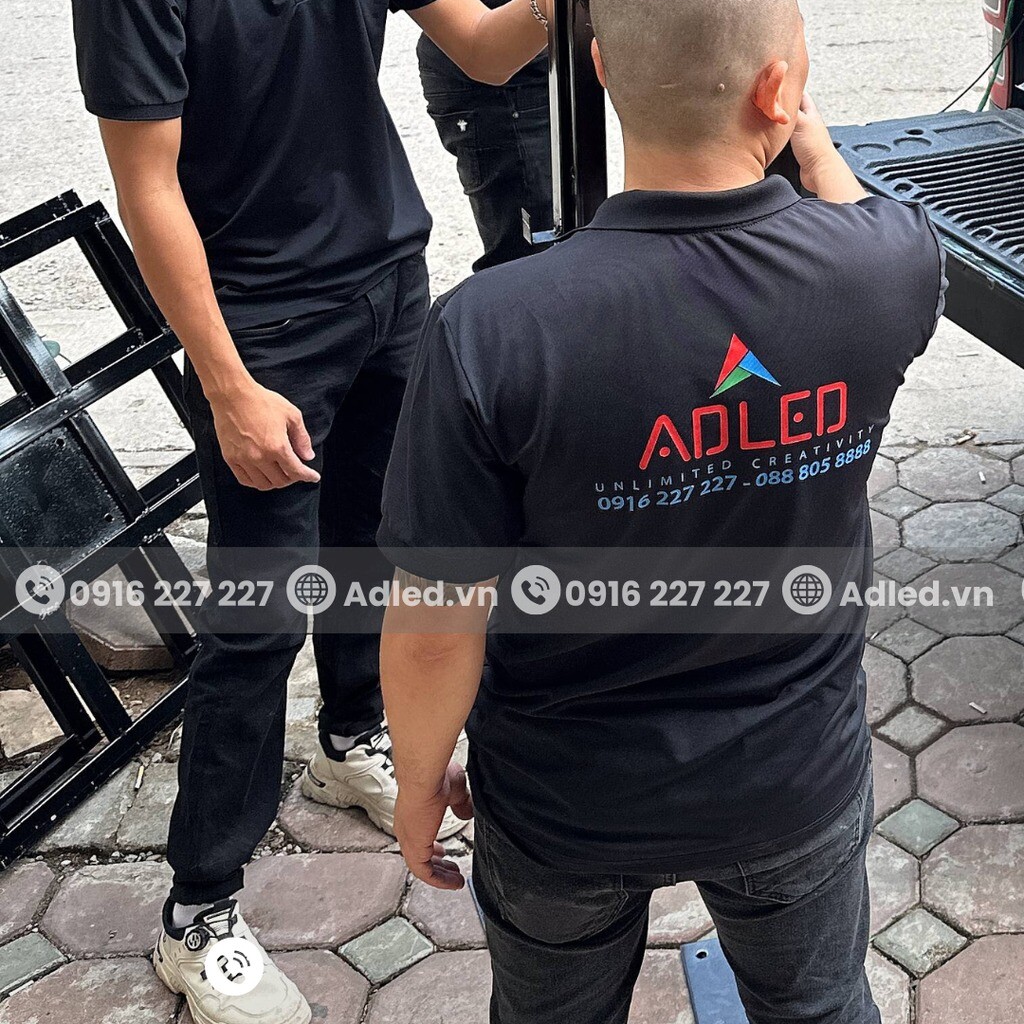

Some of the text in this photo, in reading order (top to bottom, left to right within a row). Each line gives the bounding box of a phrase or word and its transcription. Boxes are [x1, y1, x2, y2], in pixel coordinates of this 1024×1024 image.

[595, 424, 875, 492] UNLIMITED CREATIVITY
[638, 381, 848, 470] ADLED
[597, 492, 651, 512] 0916
[656, 485, 695, 506] 227
[700, 474, 738, 496] 227
[755, 468, 794, 488] 088
[798, 460, 831, 481] 805
[834, 439, 872, 470] 8888
